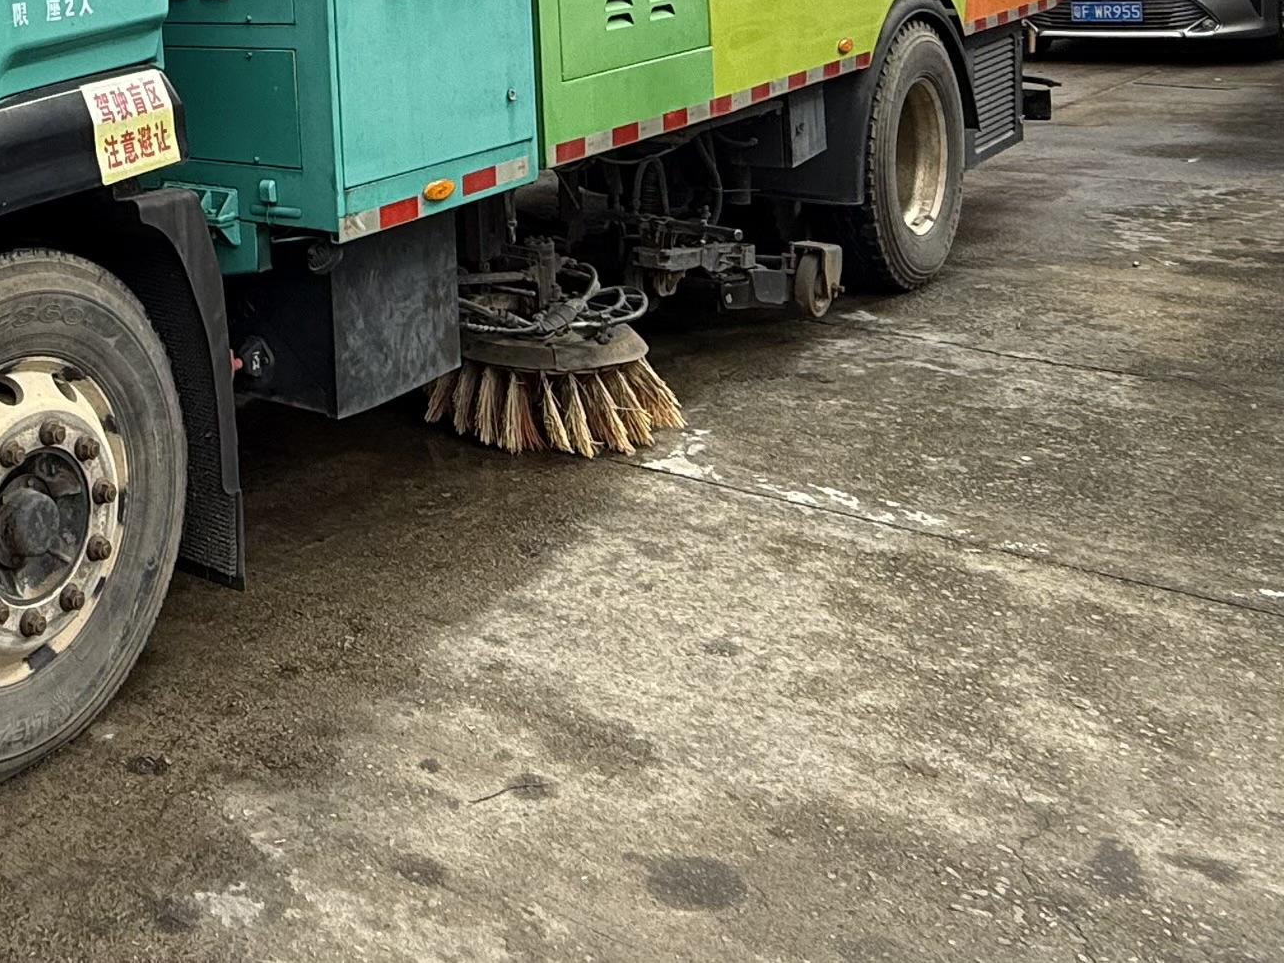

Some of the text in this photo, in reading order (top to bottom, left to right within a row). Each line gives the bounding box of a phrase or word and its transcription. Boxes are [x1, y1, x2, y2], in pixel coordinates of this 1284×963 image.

[94, 80, 164, 123] 驾驶盲区
[104, 120, 171, 170] 注意避让
